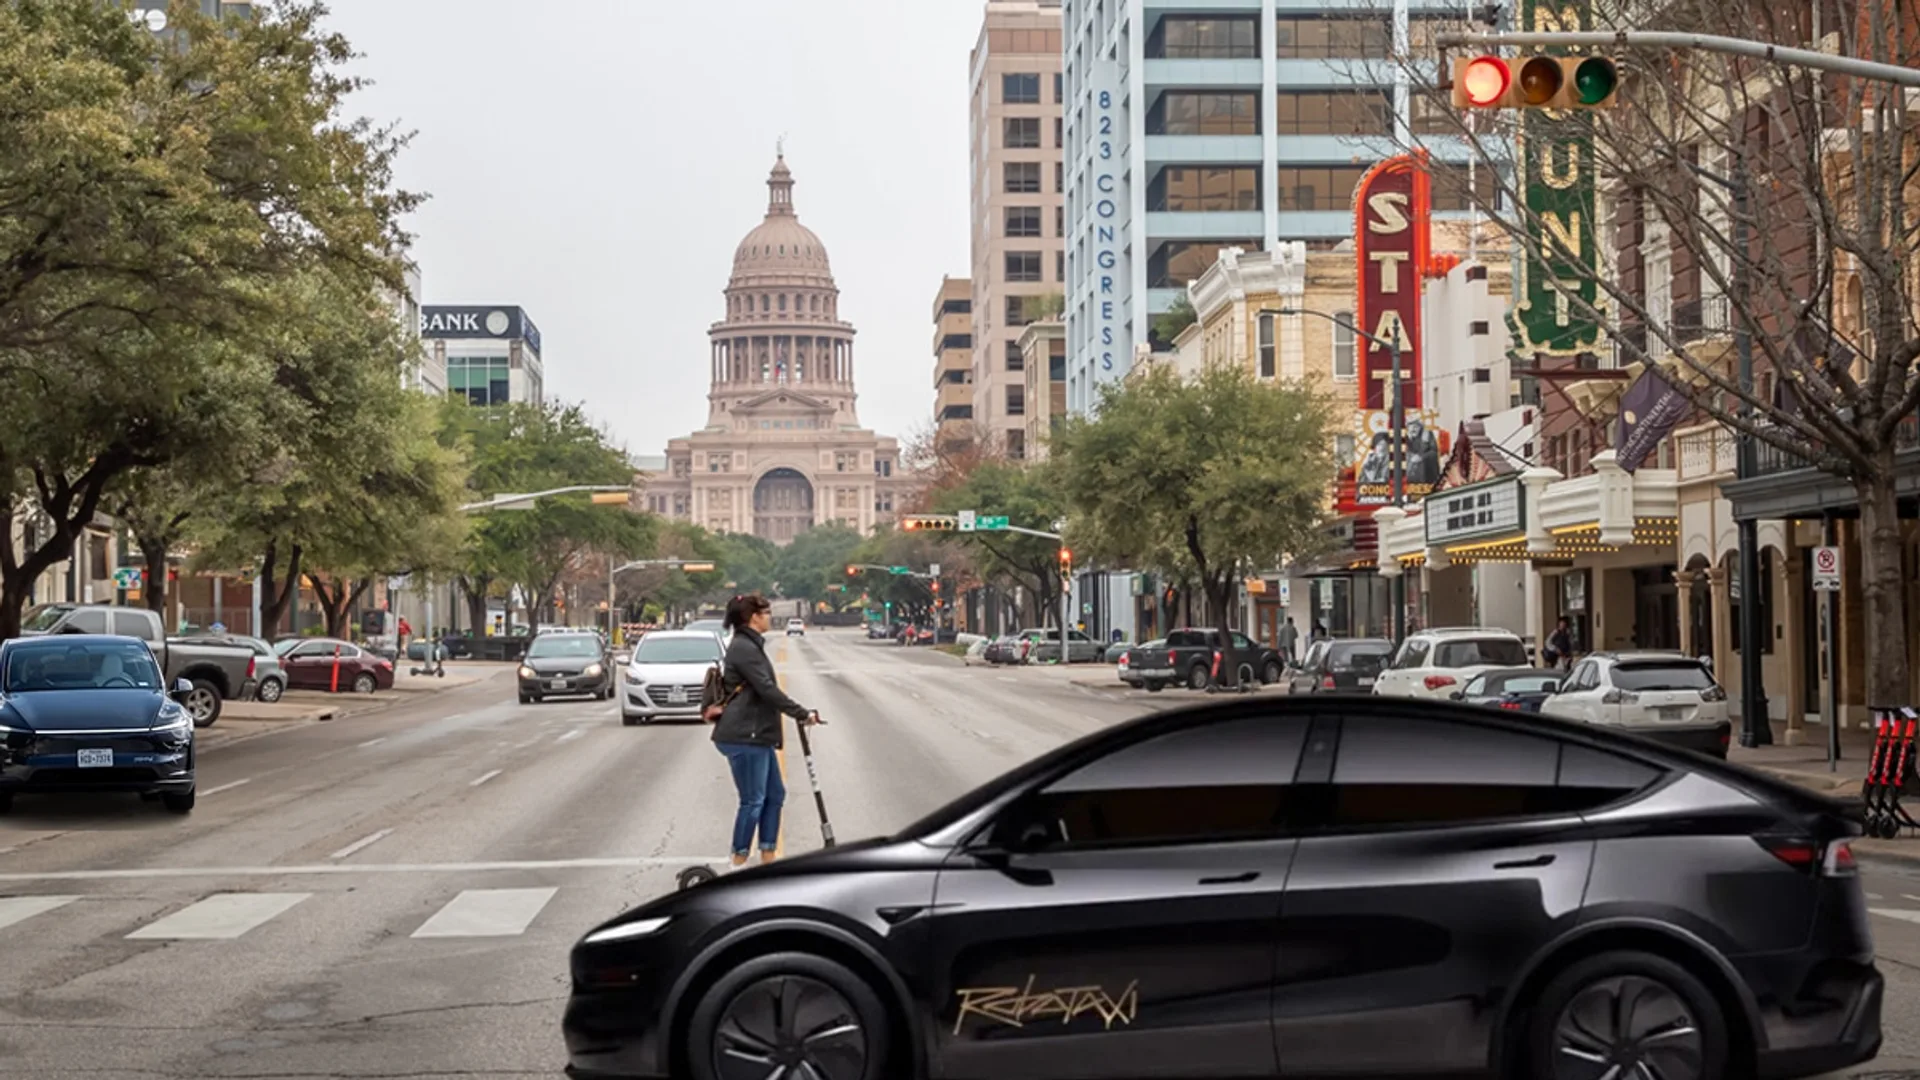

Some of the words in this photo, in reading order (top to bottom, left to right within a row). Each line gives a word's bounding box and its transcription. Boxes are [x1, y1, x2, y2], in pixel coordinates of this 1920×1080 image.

[1099, 91, 1112, 160] 823
[1533, 4, 1581, 327] MUNT
[1097, 174, 1115, 371] CONGRESS
